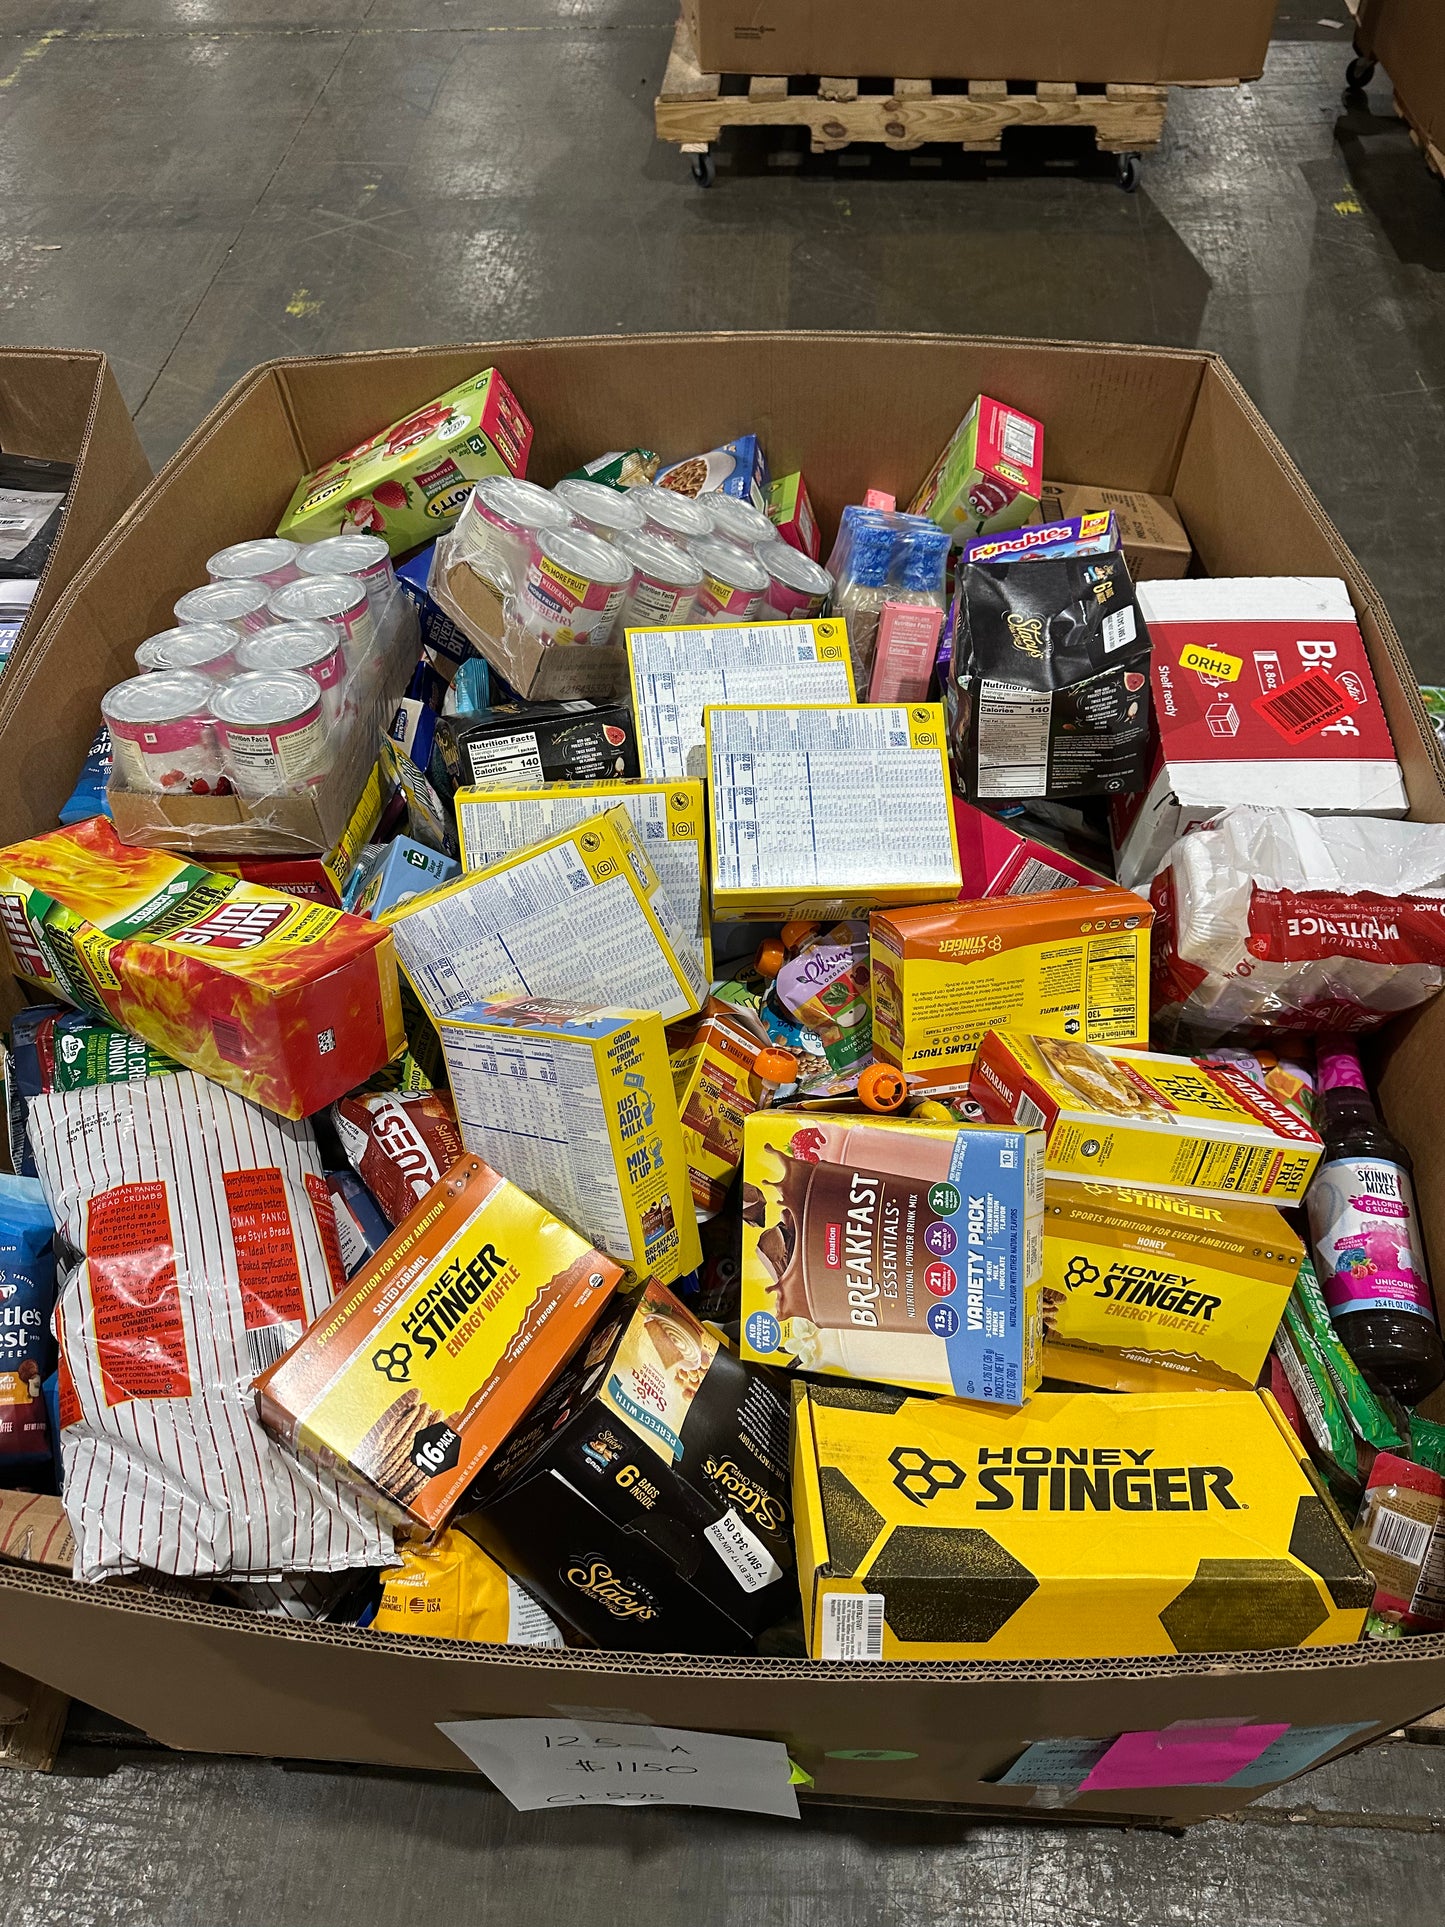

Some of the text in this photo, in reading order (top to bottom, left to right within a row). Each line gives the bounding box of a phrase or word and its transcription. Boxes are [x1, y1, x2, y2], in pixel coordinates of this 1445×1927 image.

[470, 436, 485, 452] 12
[969, 526, 1073, 562] Funables
[551, 568, 587, 591] MORE FRUIT
[711, 582, 731, 598] FRUIT
[542, 577, 575, 608] WILDERNESS
[542, 595, 561, 610] FRUIT
[662, 591, 676, 600] Facts
[447, 629, 466, 656] BIT
[1008, 613, 1045, 660] Stacy's
[1187, 653, 1232, 675] ORH3
[1262, 663, 1277, 690] 8.8oz
[1158, 665, 1178, 717] Shelf ready
[980, 706, 1015, 714] Calories
[469, 733, 536, 751] Nutrition Facts
[474, 757, 540, 776] Calories 140
[411, 852, 425, 866] 12
[211, 882, 236, 907] SIZE
[141, 885, 221, 936] MONSTER
[1413, 903, 1438, 912] PACK
[174, 901, 260, 945] SLIM
[220, 902, 291, 948] JIM
[939, 936, 988, 953] STINGER
[804, 947, 855, 985] Plum
[1087, 1011, 1101, 1019] 130
[612, 1030, 631, 1045] GOOD
[1105, 1029, 1135, 1038] Nutrition
[108, 1039, 127, 1076] ONION
[606, 1035, 641, 1059] NUTRITION
[616, 1049, 635, 1063] FROM
[911, 1046, 943, 1060] TRUST
[610, 1054, 644, 1077] THE START
[410, 1070, 421, 1091] GOOD
[616, 1091, 638, 1115] JUST
[1173, 1073, 1235, 1114] FISH
[619, 1106, 641, 1128] ADD
[1224, 1072, 1315, 1141] ZATARAIN'S
[620, 1120, 644, 1142] MILK
[626, 1150, 650, 1173] MIX
[1002, 1153, 1012, 1165] 10
[1224, 1146, 1246, 1189] Calories 60
[1250, 1149, 1273, 1192] Nutrition Facts
[226, 1173, 256, 1187] everything
[629, 1160, 652, 1185] IT UP
[1274, 1162, 1295, 1187] FRI
[1285, 1156, 1310, 1193] FISH
[1357, 1170, 1395, 1186] SKINNY
[123, 1192, 163, 1203] CRUMBS
[134, 1184, 162, 1193] PANKO
[270, 1185, 283, 1194] Now
[1365, 1181, 1396, 1197] MIXES
[110, 1202, 161, 1216] specifically
[232, 1201, 263, 1213] something
[261, 1211, 287, 1223] PANKO
[986, 1192, 994, 1241] 3-STRAWBERRY
[1116, 1191, 1225, 1222] STINGER
[1365, 1199, 1404, 1211] CALORIES
[1372, 1206, 1400, 1217] SUGAR
[122, 1233, 169, 1247] texture and
[248, 1226, 291, 1242] Style Bread
[930, 1229, 942, 1247] 3x
[1069, 1209, 1245, 1254] SPORTS NUTRITION FOR EVERY AMBITION
[1136, 1236, 1167, 1250] HONEY
[826, 1227, 839, 1267] Carnation
[845, 1172, 880, 1329] BREAKFAST
[882, 1204, 900, 1299] ESSENTIALS
[905, 1193, 918, 1318] NUTRITIONAL POWDER DRINK MIX
[316, 1200, 446, 1348] SPORTS NUTRITION FOR EVERY AMBITION
[966, 1195, 986, 1331] VARIETY PACK
[1108, 1262, 1197, 1286] HONEY
[372, 1254, 429, 1317] SALTED CARAMEL
[930, 1271, 941, 1288] 21
[1374, 1278, 1415, 1290] UNICORN
[401, 1256, 462, 1334] HONEY
[410, 1243, 508, 1360] STINGER
[1094, 1275, 1223, 1321] STINGER
[1374, 1299, 1395, 1309] 25.4 FL
[445, 1306, 486, 1359] ENERGY
[480, 1264, 521, 1313] WAFFLE
[934, 1309, 947, 1330] 13g
[1104, 1303, 1210, 1336] ENERGY WAFFLE
[512, 1299, 558, 1359] PREPARE PERFORM
[762, 1318, 771, 1348] TASTE
[640, 1370, 664, 1395] SINGLES
[642, 1363, 666, 1389] Classic
[631, 1368, 668, 1412] Sabra
[983, 1386, 993, 1398] 10
[614, 1390, 677, 1447] PERFECT WITH
[416, 1427, 457, 1474] 16 PACK
[738, 1431, 756, 1449] STORY
[977, 1447, 1155, 1466] HONEY
[615, 1464, 660, 1499] 6 BAGS
[975, 1465, 1241, 1512] STINGER
[629, 1485, 656, 1510] INSIDE
[703, 1459, 786, 1531] Stacy's
[723, 1517, 762, 1570] 5M1 343 09
[710, 1525, 757, 1587] USE JUN 2025
[567, 1562, 657, 1620] Stacy's
[427, 1603, 441, 1613] USA
[566, 1758, 699, 1775] $1150
